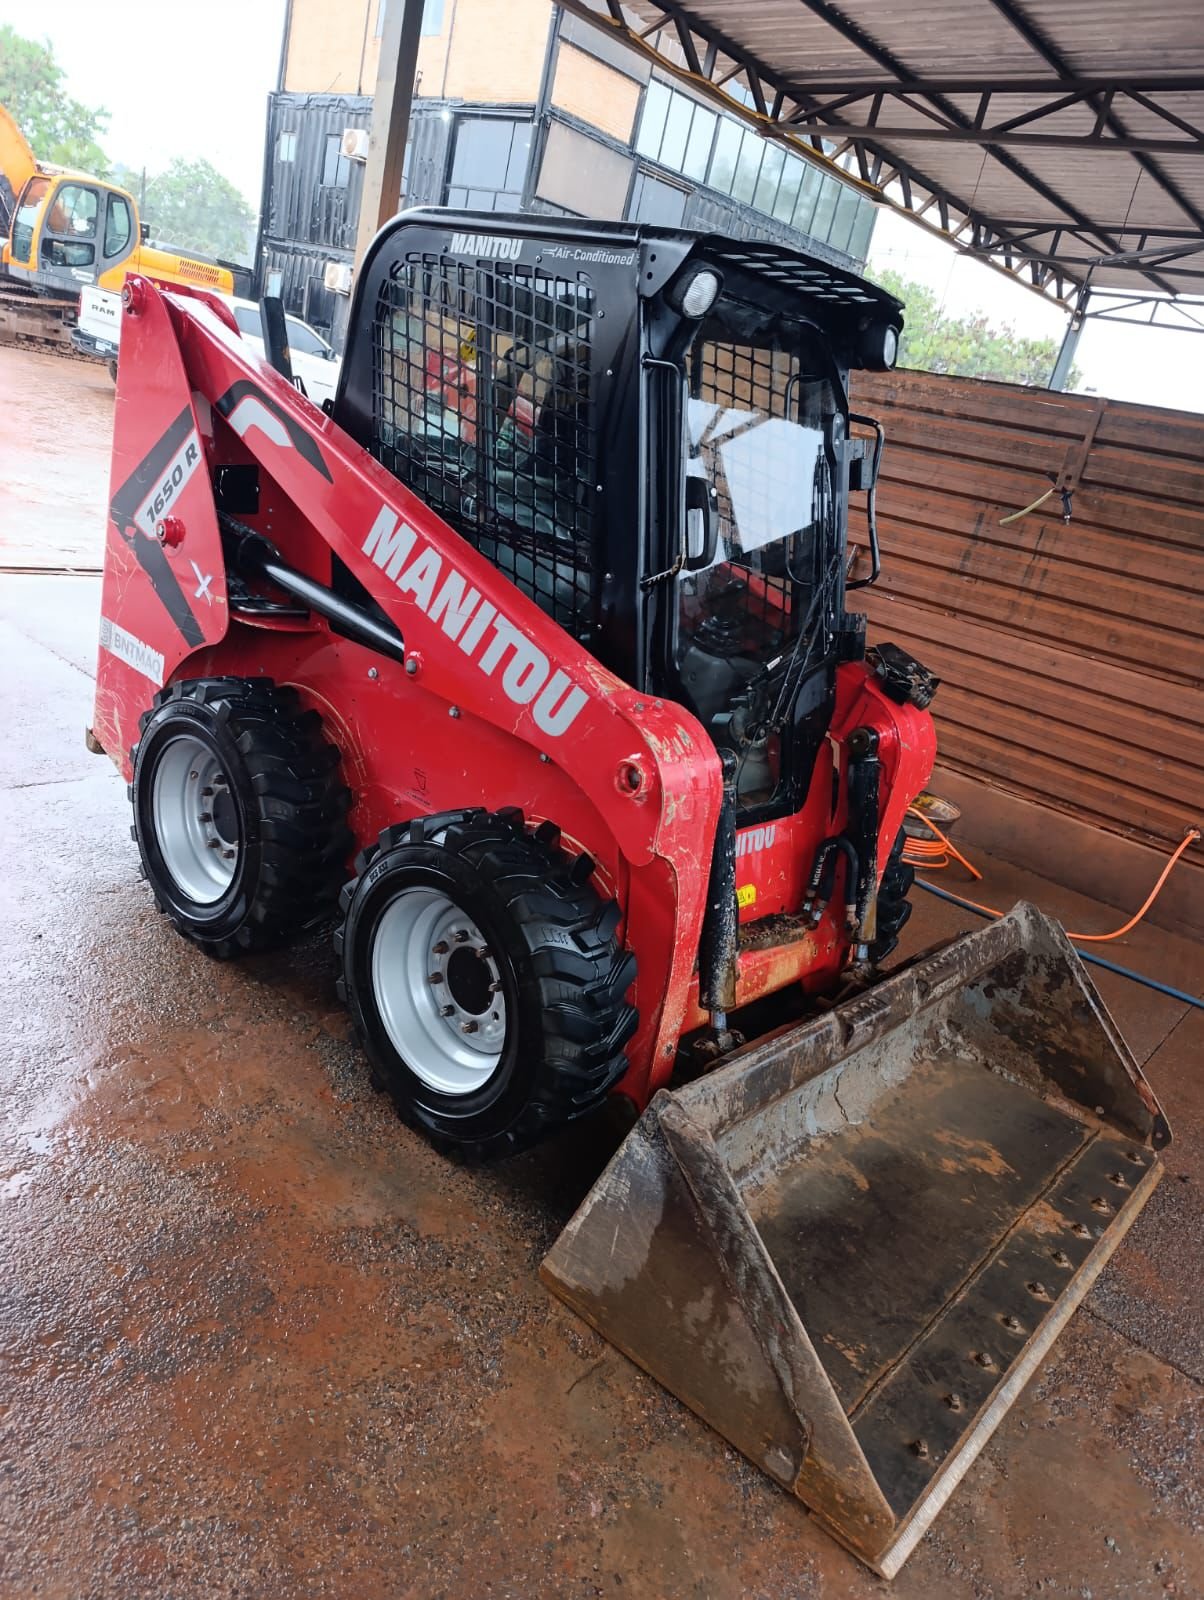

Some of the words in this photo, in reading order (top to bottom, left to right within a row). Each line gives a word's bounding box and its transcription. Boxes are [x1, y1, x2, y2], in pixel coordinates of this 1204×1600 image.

[450, 233, 523, 260] MANITOU
[556, 249, 635, 265] Air-Conditioned
[91, 304, 115, 317] RAM
[147, 465, 183, 523] 1650
[185, 443, 198, 467] R
[361, 504, 590, 737] MANITOU
[114, 632, 160, 680] BNTMAQ
